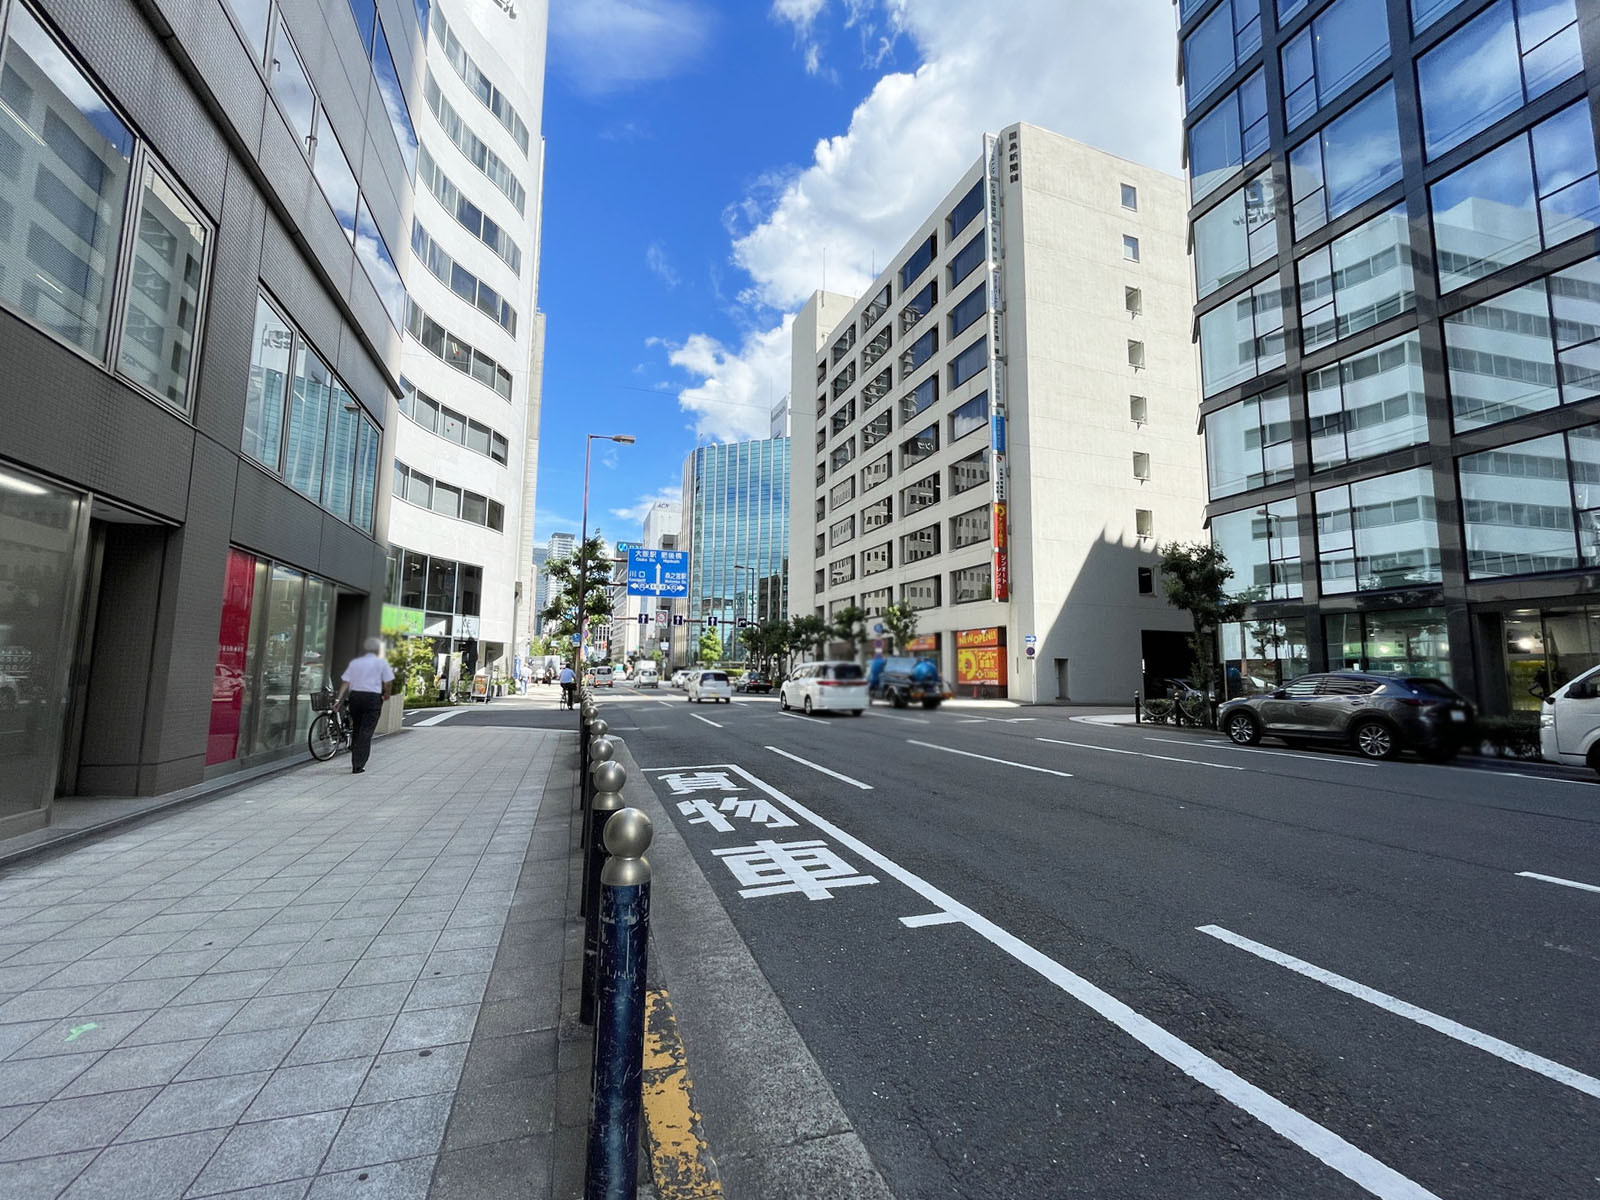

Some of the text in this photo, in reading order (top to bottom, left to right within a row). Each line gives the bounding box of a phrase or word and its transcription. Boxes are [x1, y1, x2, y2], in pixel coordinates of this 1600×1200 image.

[629, 570, 646, 578] 川口
[657, 771, 880, 901] 貨物車
